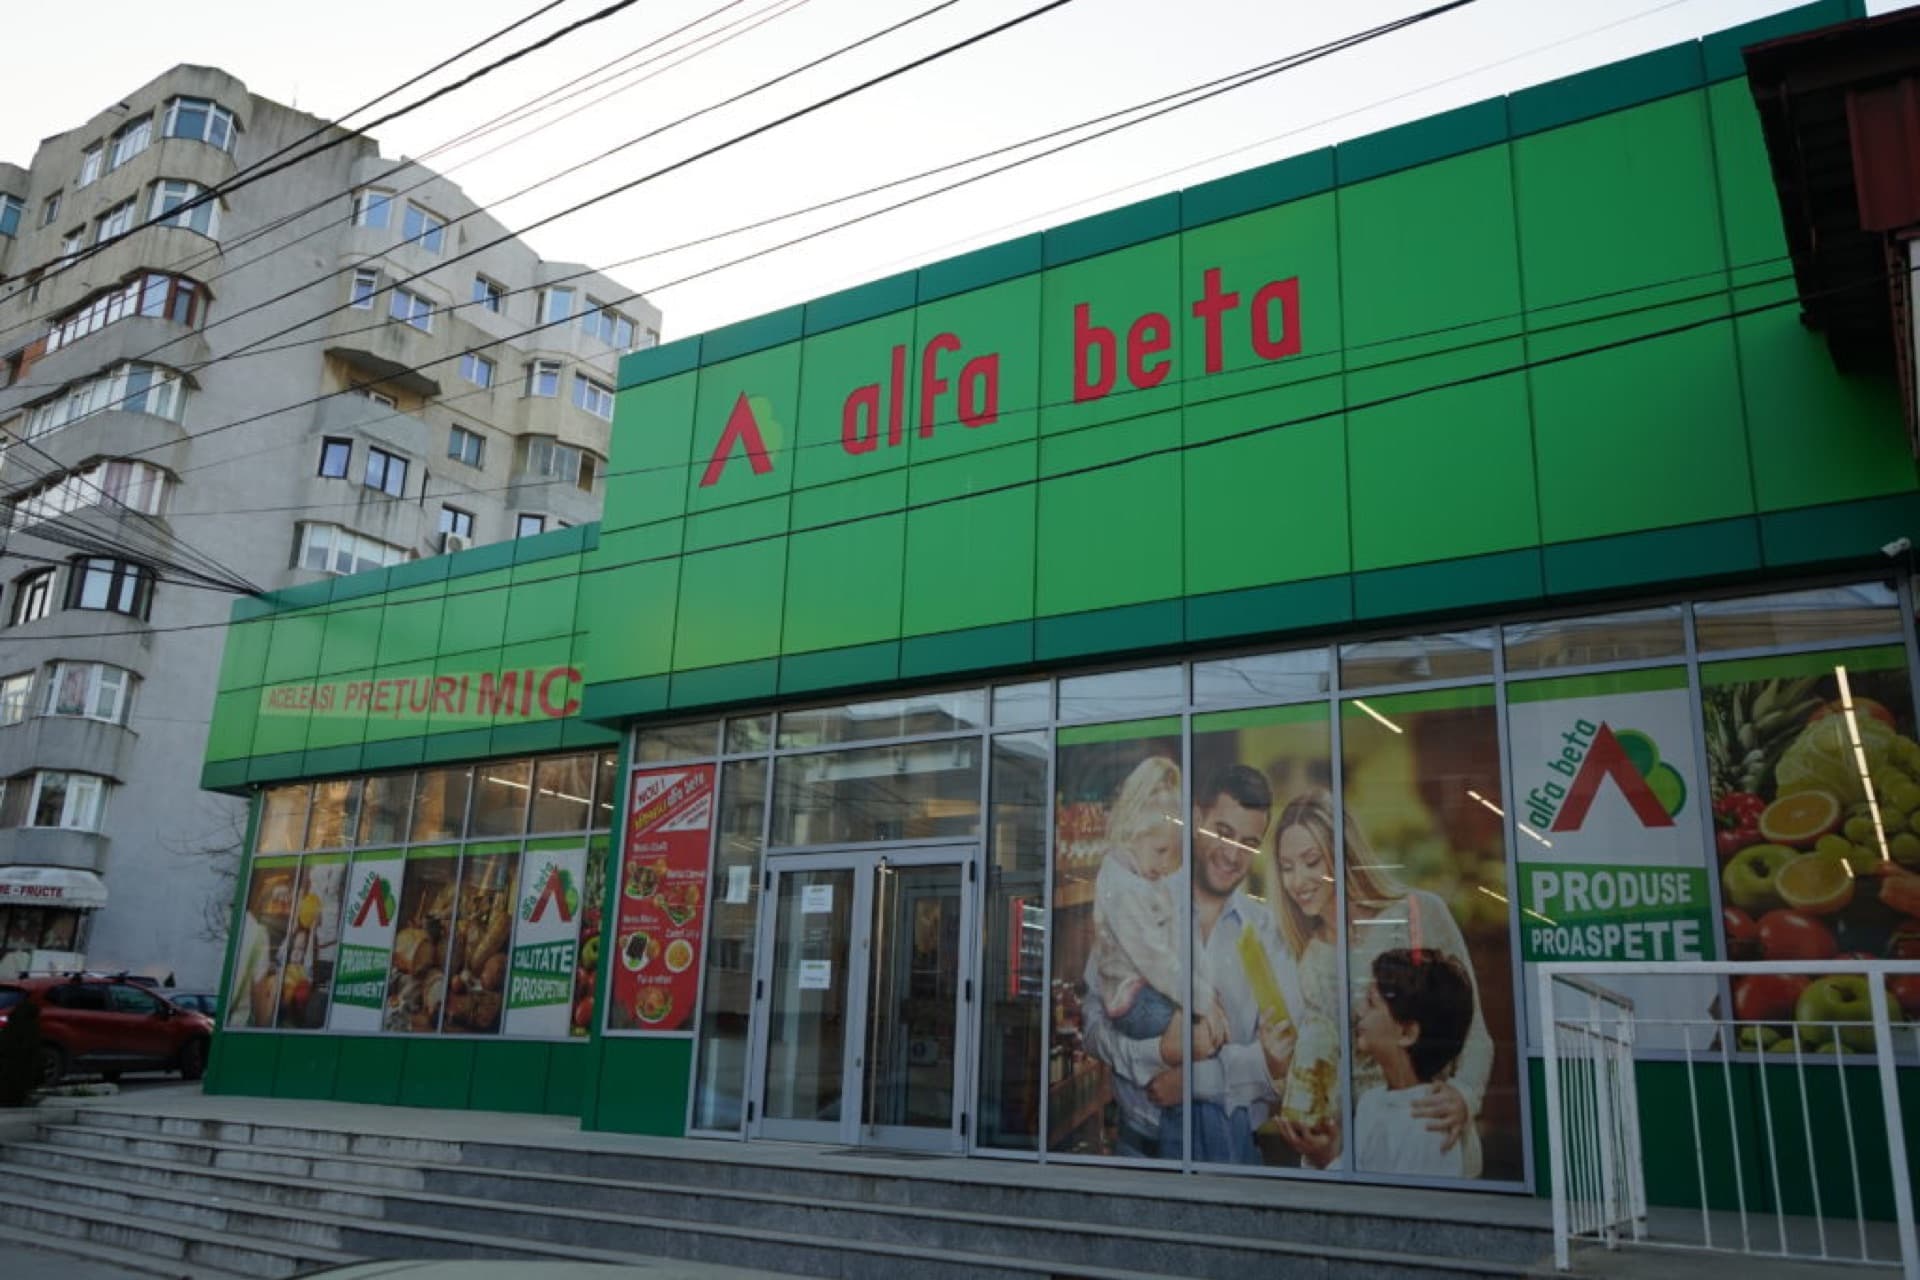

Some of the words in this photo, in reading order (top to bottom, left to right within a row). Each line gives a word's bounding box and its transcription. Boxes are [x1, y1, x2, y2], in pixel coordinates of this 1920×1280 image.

[841, 332, 999, 455] alfa
[1074, 267, 1302, 404] beta
[1525, 781, 1565, 829] alfa
[1547, 719, 1597, 777] beta
[1531, 870, 1693, 915] PRODUSE
[1532, 919, 1703, 962] PROASPETE
